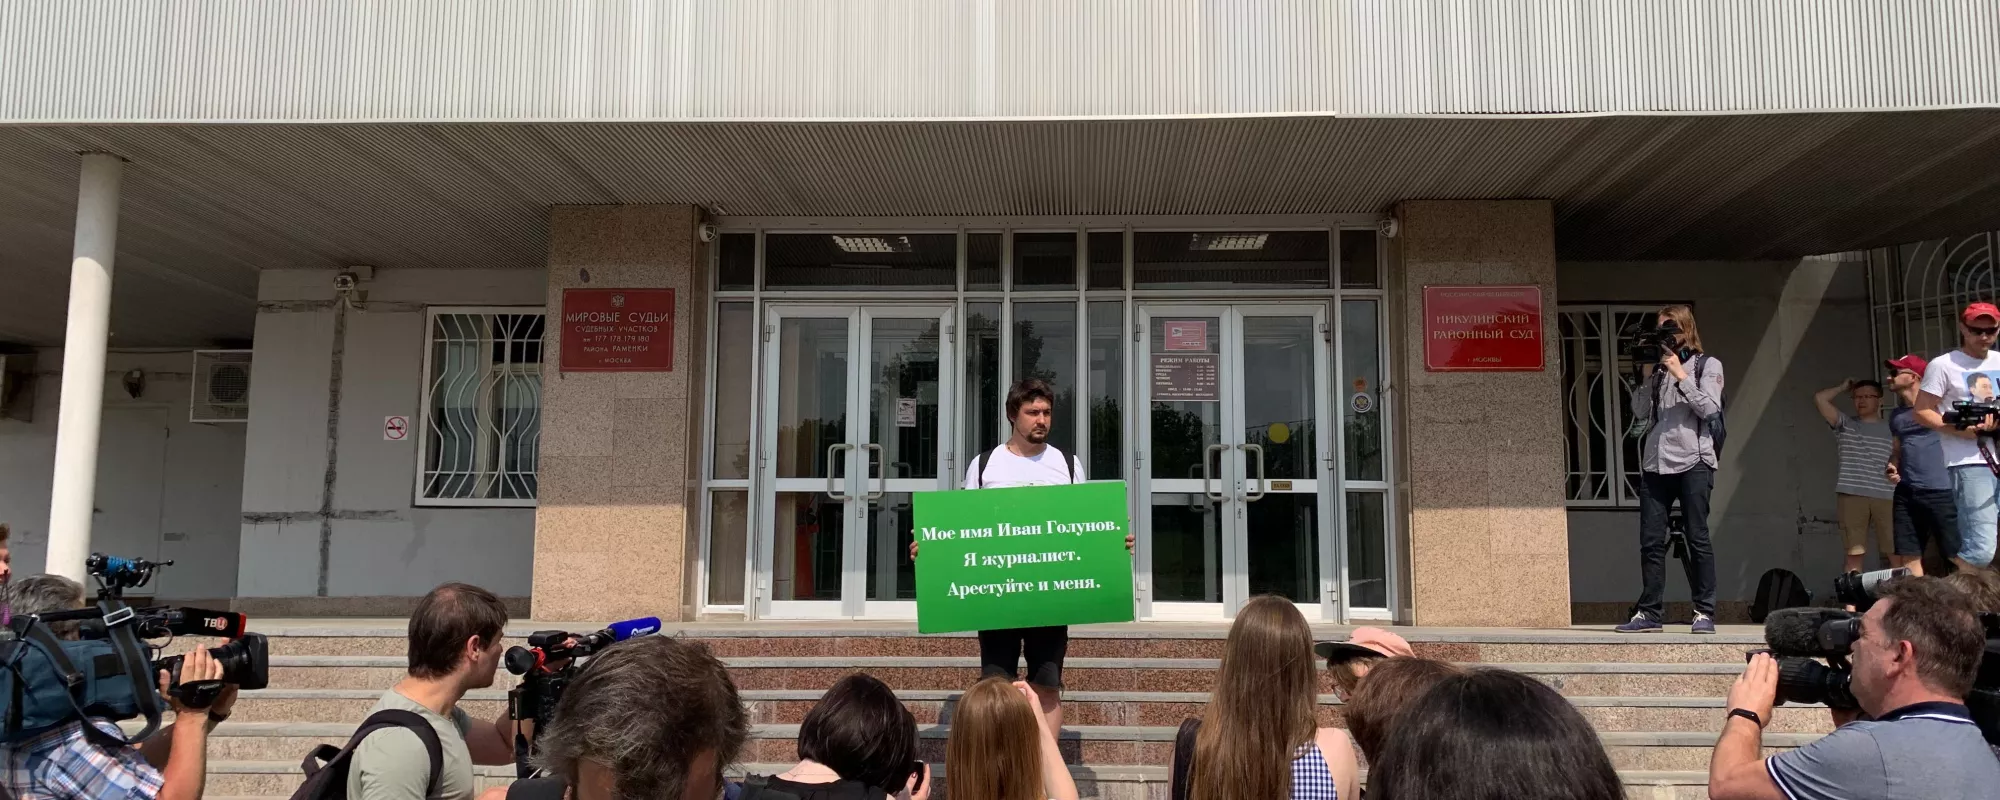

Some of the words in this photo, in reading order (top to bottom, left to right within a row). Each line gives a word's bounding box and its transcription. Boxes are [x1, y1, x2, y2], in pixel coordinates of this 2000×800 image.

[565, 312, 620, 322] МИРОВЫЕ
[628, 312, 669, 322] СУДЬИ
[1436, 314, 1529, 324] НИКУЛИНСКИЙ
[575, 325, 614, 333] СУДЕБНЫХ
[618, 325, 658, 333] УЧАСТКОВ
[1433, 329, 1504, 339] РАЙОННЫЙ
[1509, 329, 1535, 340] СУД
[921, 527, 956, 541] Мое
[960, 527, 993, 539] имя
[997, 523, 1042, 537] Иван
[1046, 520, 1121, 536] Голунов.
[964, 552, 977, 567] Я
[982, 550, 1081, 568] журналист.
[947, 578, 1034, 600] Арестуйте
[1038, 580, 1049, 591] и
[1053, 578, 1101, 590] меня.
